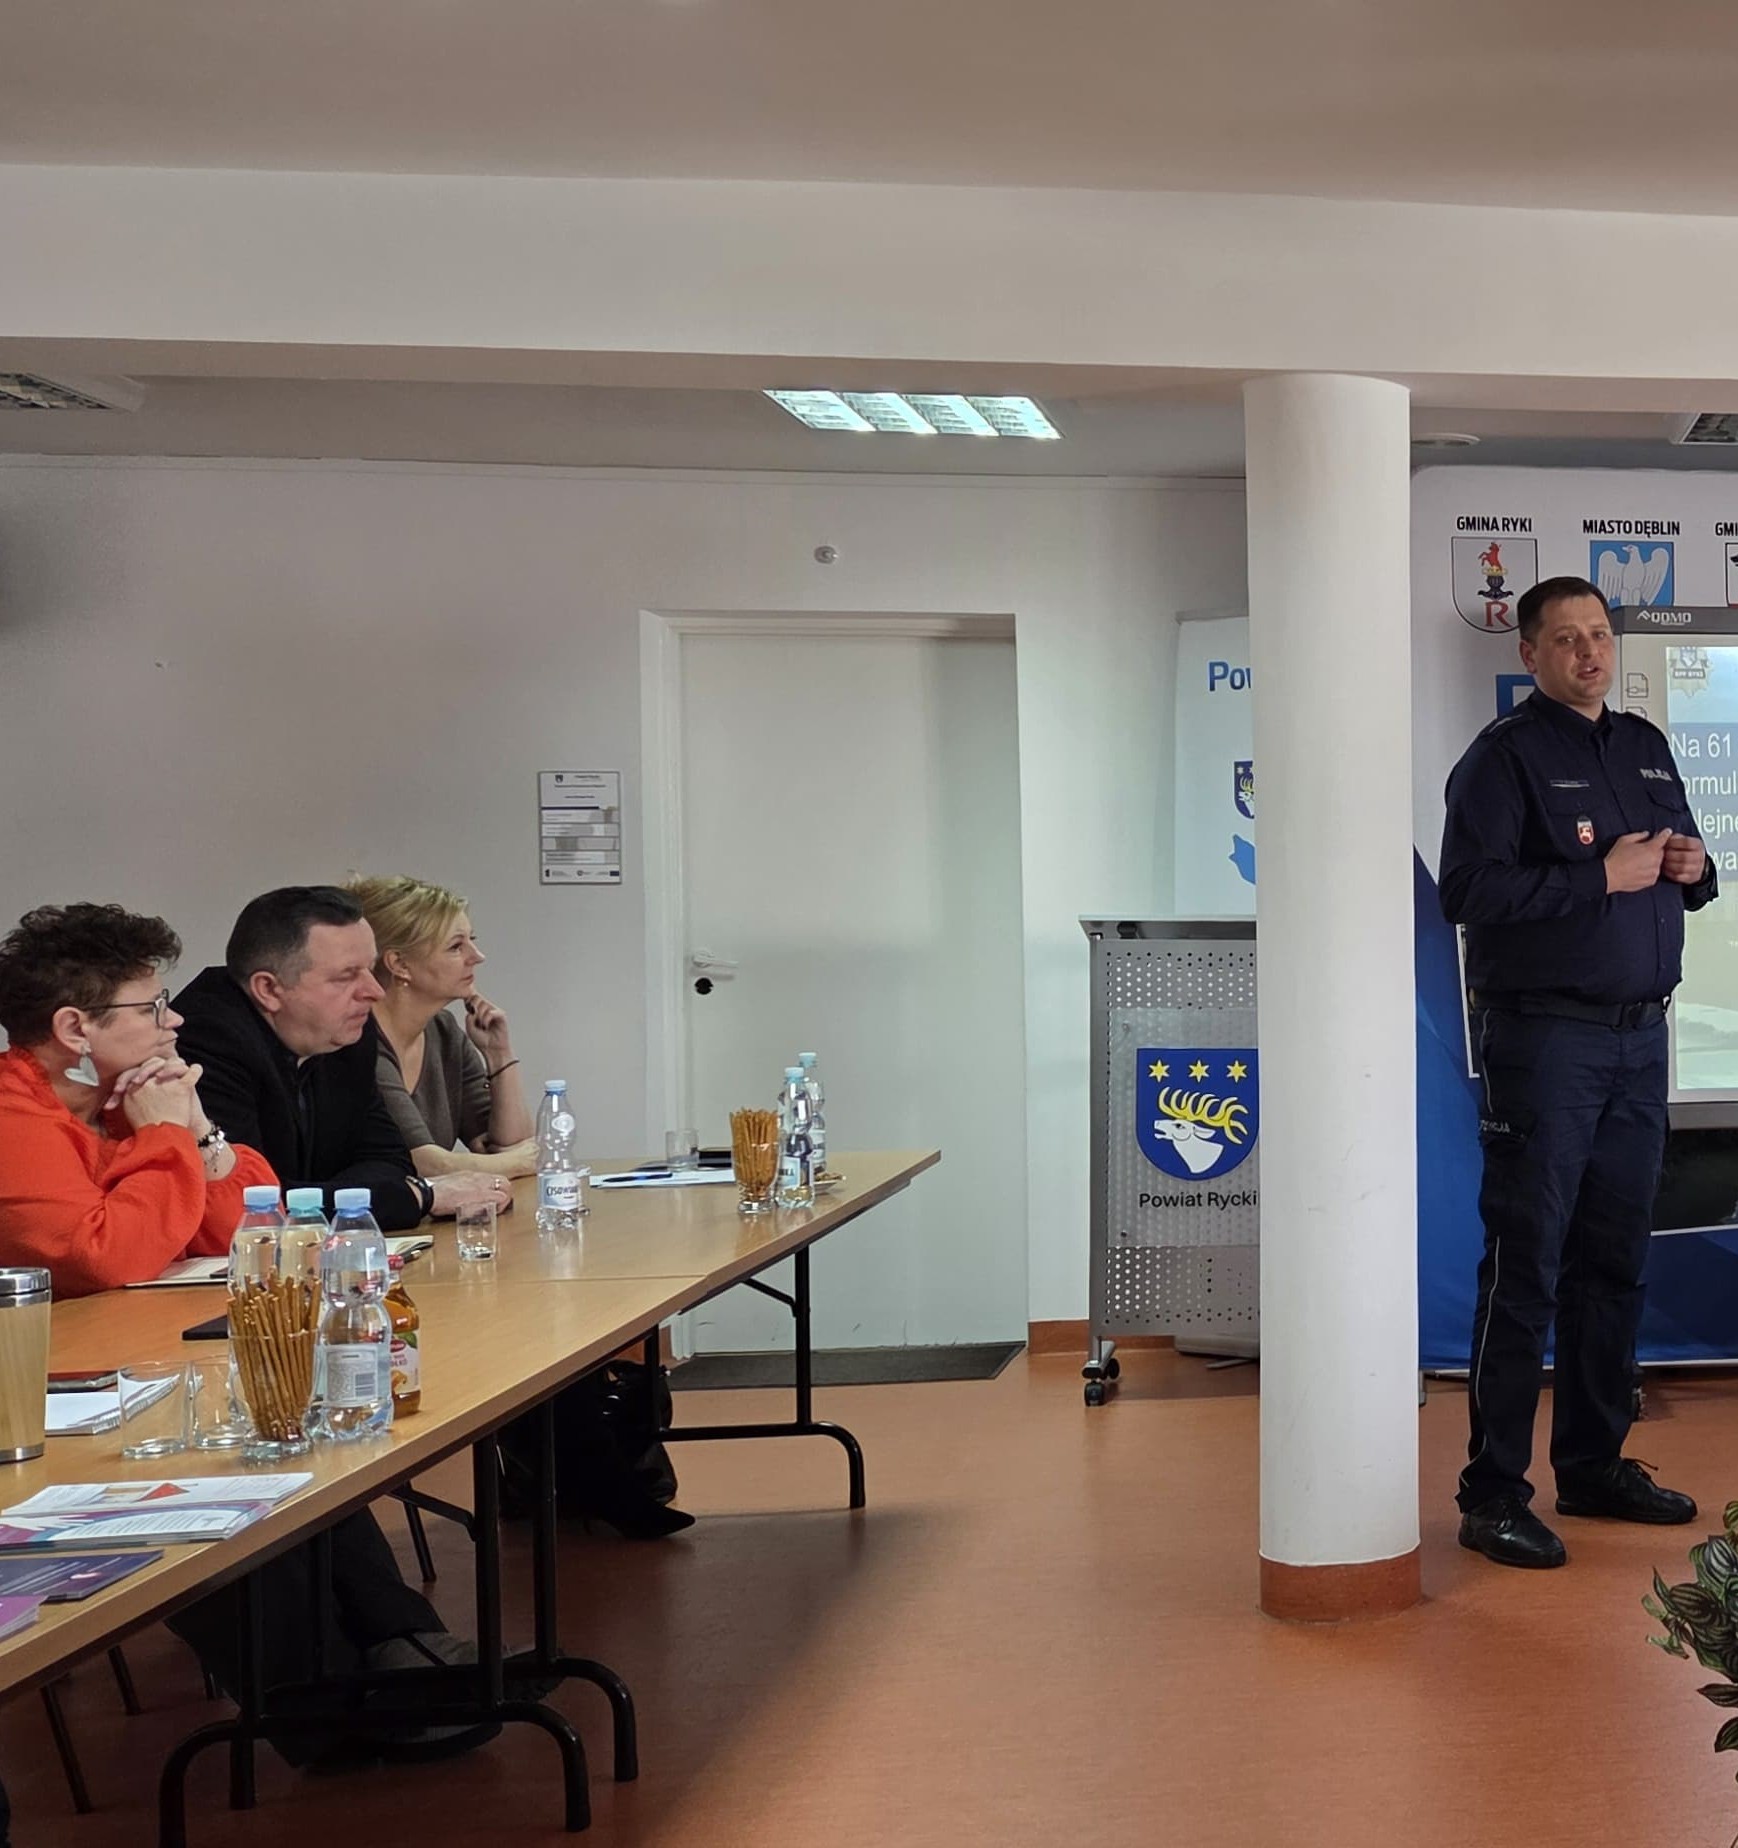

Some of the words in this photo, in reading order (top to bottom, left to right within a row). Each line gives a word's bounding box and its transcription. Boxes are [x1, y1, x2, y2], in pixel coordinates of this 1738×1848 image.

[1456, 516, 1499, 532] GMINA
[1501, 517, 1532, 532] RYKI
[1582, 520, 1632, 535] MIASTO
[1634, 520, 1680, 538] DĘBLIN
[1485, 600, 1512, 627] R
[1670, 733, 1700, 758] Na
[1708, 732, 1731, 758] 61
[1139, 1191, 1203, 1207] Powiat
[1207, 1190, 1257, 1211] Rycki
